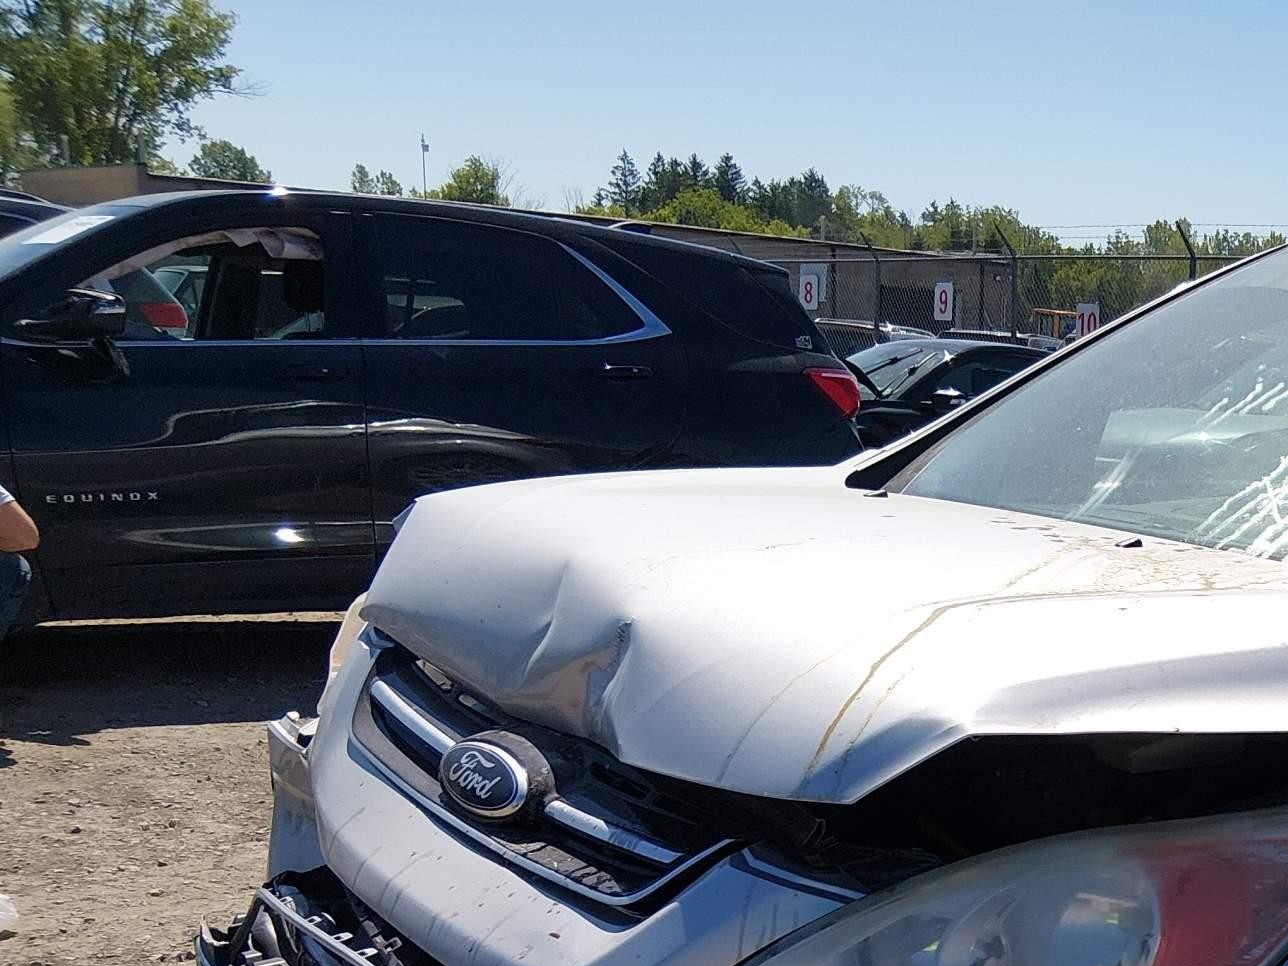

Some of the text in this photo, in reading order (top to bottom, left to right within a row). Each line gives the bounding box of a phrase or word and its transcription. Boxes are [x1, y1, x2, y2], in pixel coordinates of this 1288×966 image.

[804, 281, 813, 304] 8
[939, 289, 948, 314] 9
[1077, 311, 1097, 337] 10
[45, 491, 160, 504] EQUINOX
[449, 750, 502, 800] Ford
